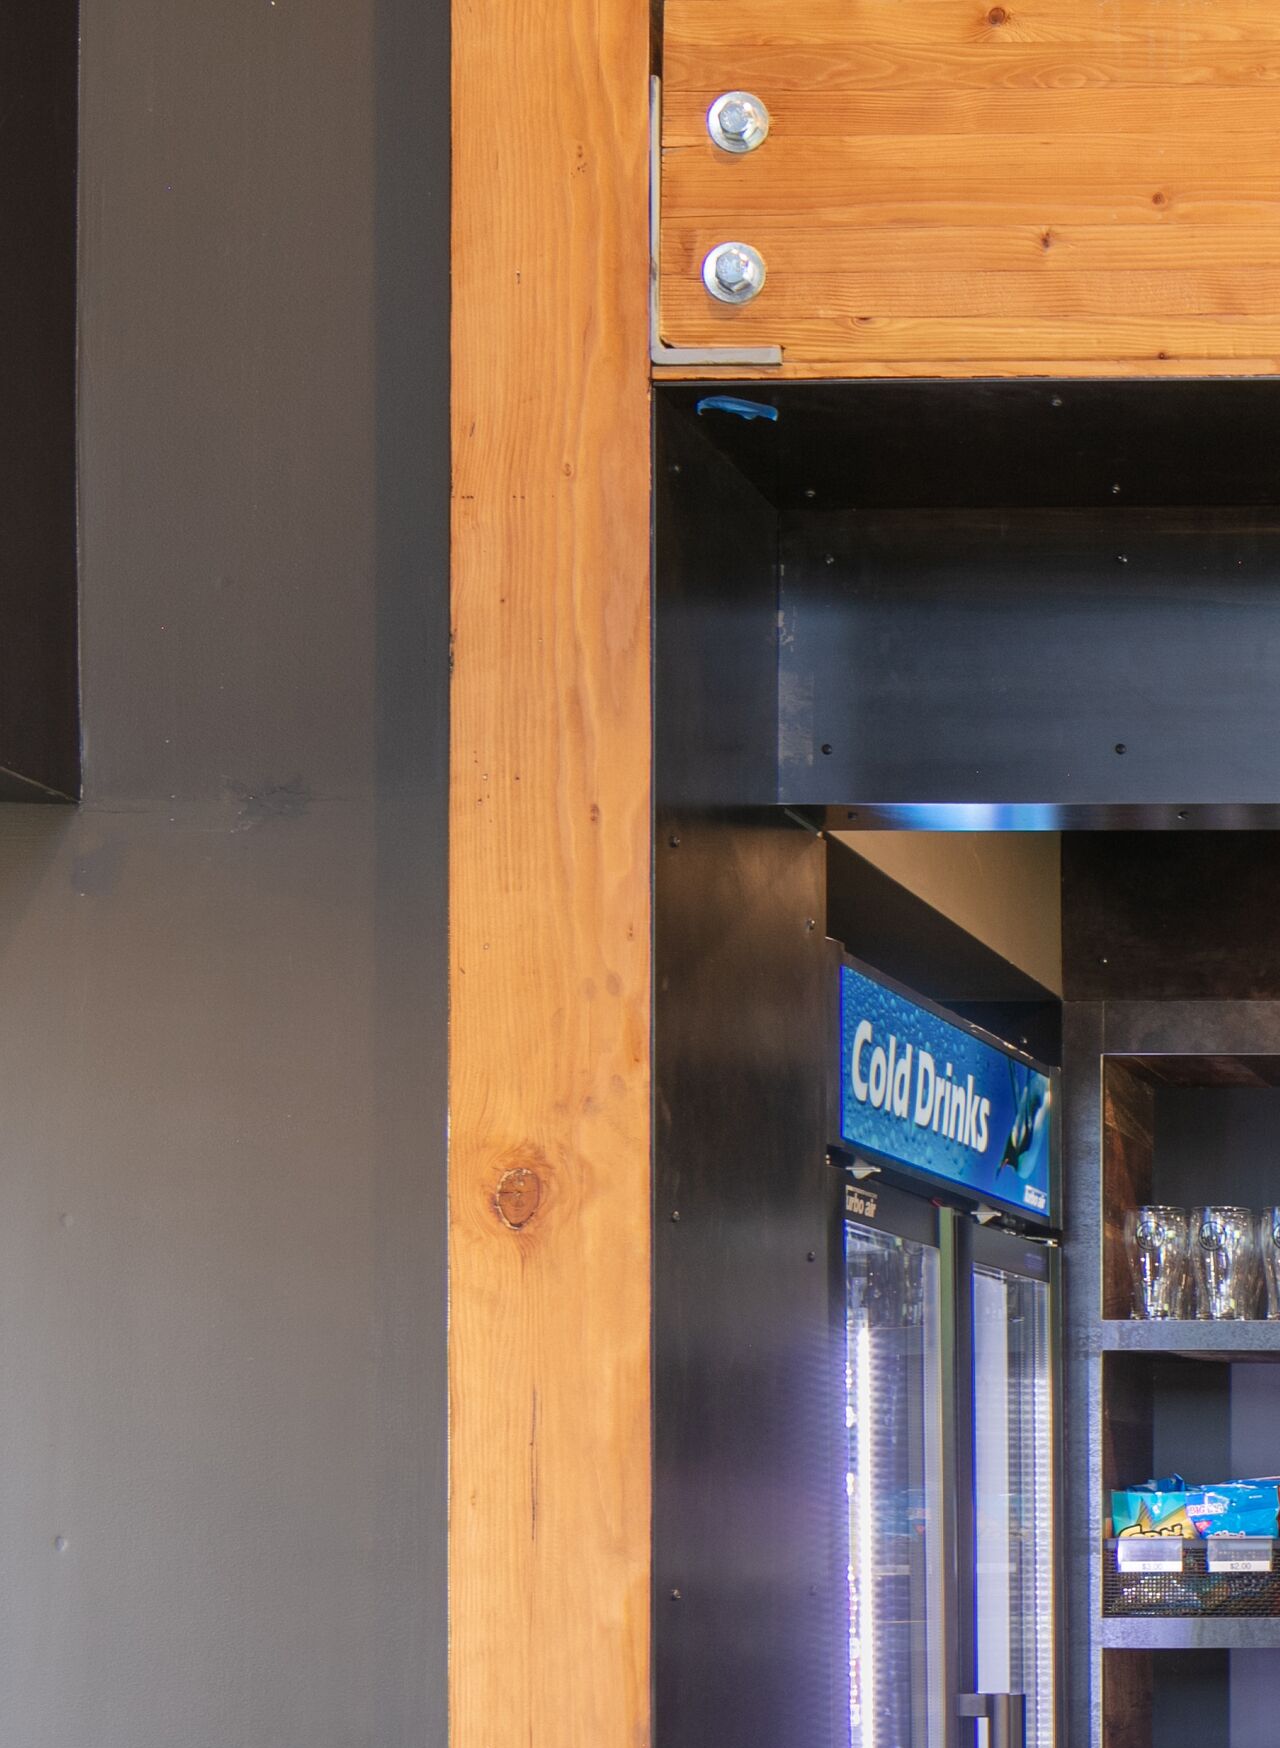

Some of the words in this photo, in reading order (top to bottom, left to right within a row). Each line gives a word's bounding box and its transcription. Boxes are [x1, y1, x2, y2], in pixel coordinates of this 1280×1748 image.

[852, 1019, 913, 1119] Cold
[914, 1051, 991, 1153] Drinks
[1230, 1562, 1251, 1571] $2.00
